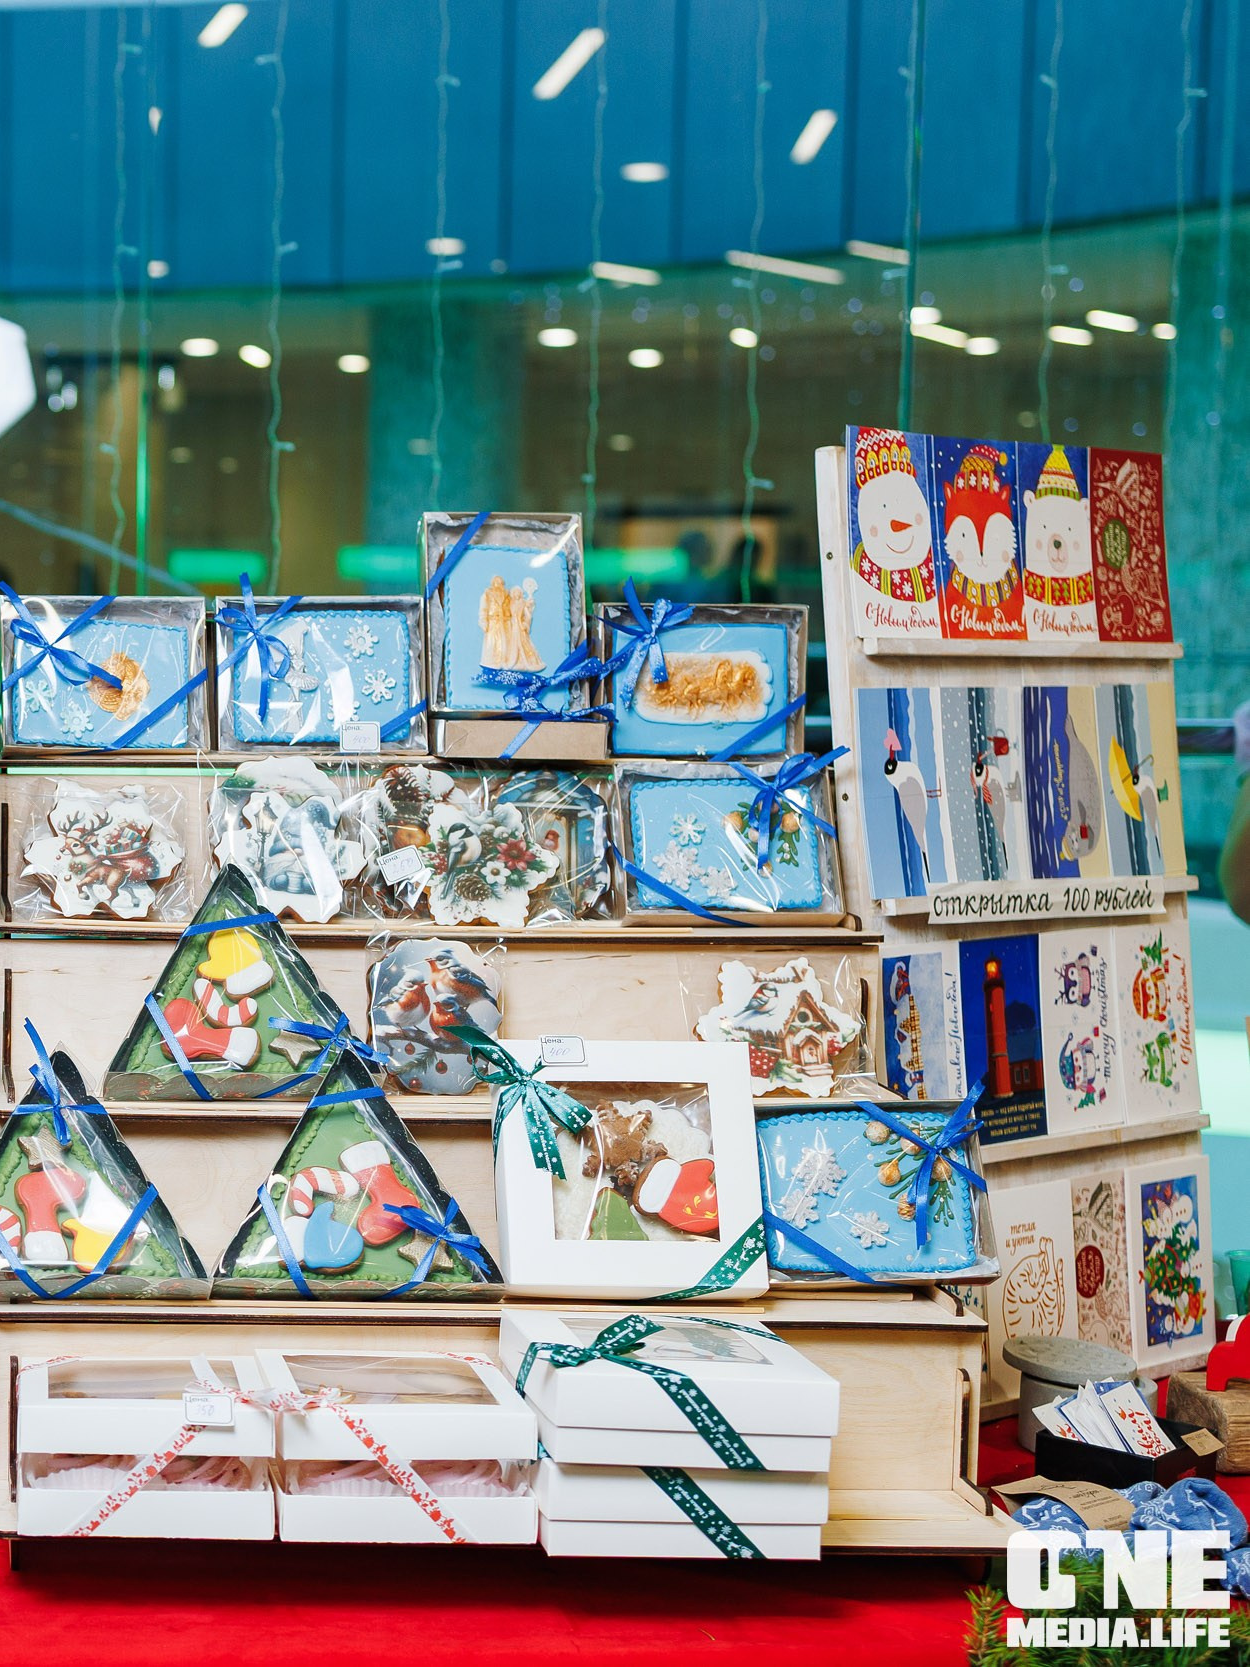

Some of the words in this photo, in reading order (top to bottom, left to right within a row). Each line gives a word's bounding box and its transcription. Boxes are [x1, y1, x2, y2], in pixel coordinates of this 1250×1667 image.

[933, 892, 1053, 917] открытка
[1064, 887, 1090, 912] 100
[1094, 880, 1155, 912] рублей
